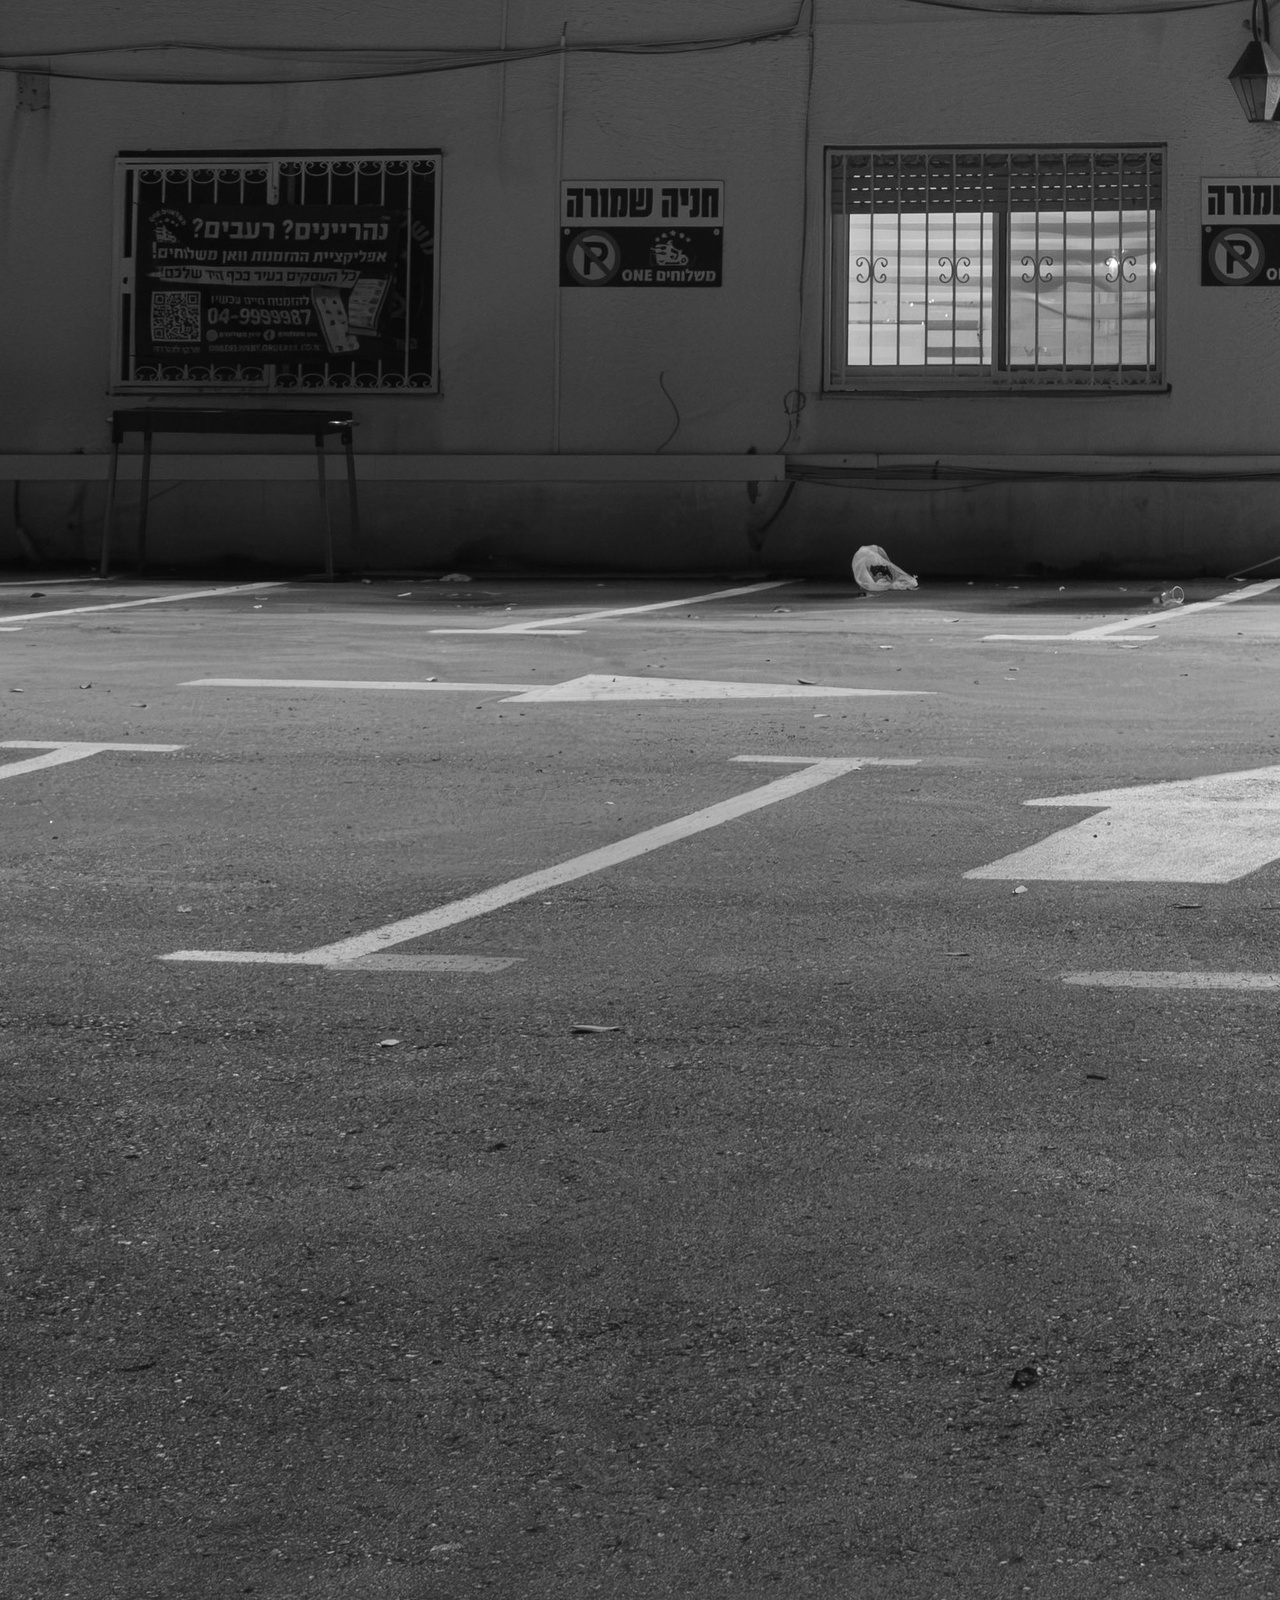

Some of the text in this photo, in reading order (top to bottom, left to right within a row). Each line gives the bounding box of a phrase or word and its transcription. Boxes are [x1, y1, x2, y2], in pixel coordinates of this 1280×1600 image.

[567, 188, 719, 218] חניה שמורה
[192, 218, 275, 240] רעבים?
[282, 219, 389, 241] נהריינים?
[222, 250, 248, 264] וואן
[250, 250, 310, 263] ההזמנות
[313, 249, 388, 266] אפליקציית
[622, 269, 716, 282] משלוחים ONE
[208, 307, 312, 325] 04-9999987
